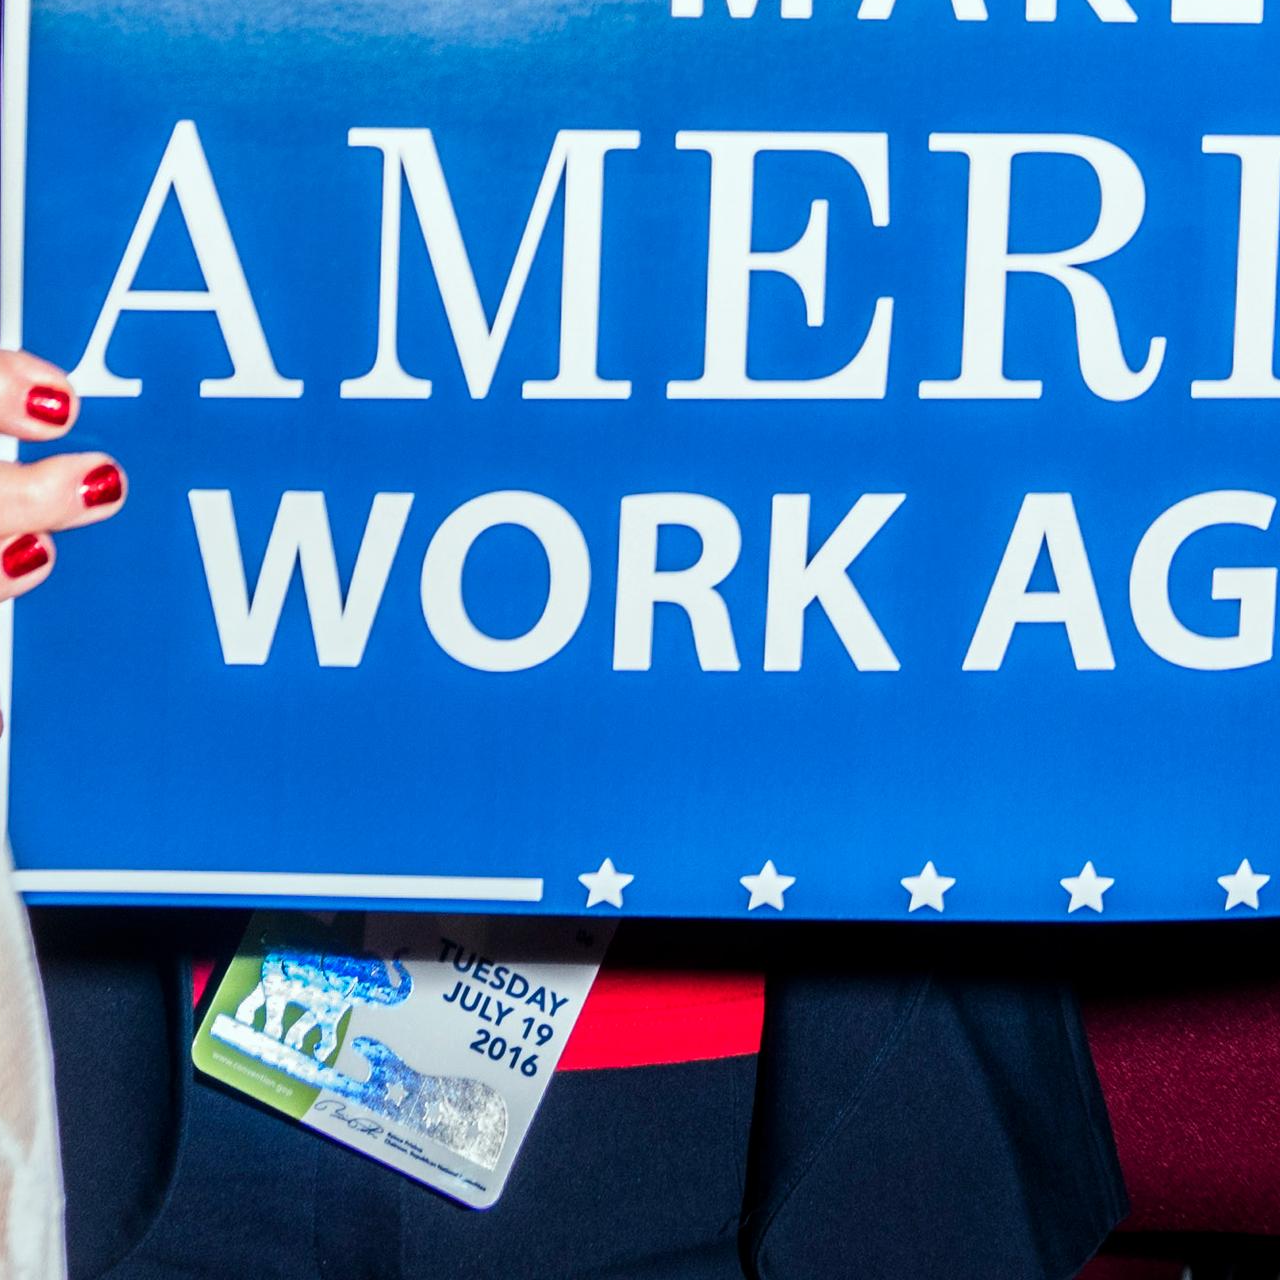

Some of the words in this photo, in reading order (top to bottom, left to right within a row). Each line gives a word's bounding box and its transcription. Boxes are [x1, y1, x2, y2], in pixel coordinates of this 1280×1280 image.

[187, 488, 906, 673] WORK
[437, 938, 570, 1018] TUESDAY
[443, 981, 511, 1030] JULY
[522, 1016, 555, 1047] 19
[470, 1030, 540, 1078] 2016
